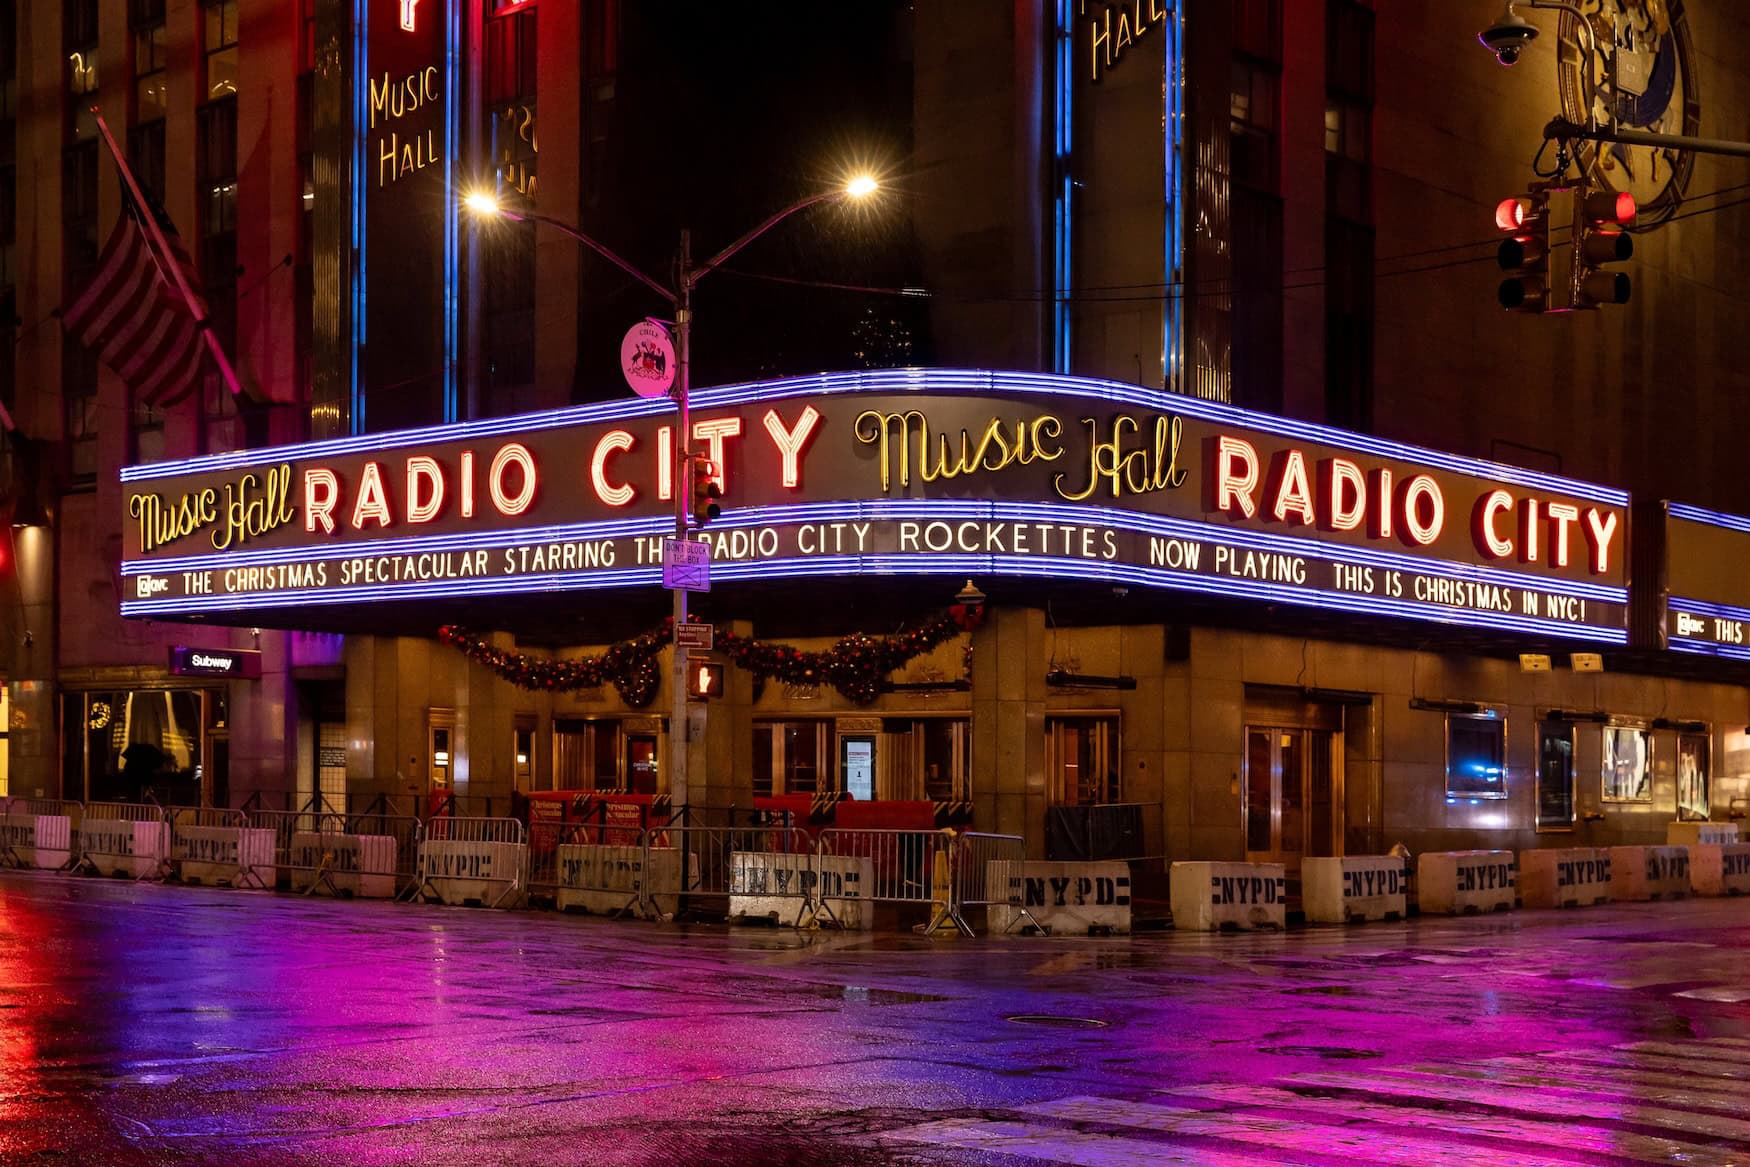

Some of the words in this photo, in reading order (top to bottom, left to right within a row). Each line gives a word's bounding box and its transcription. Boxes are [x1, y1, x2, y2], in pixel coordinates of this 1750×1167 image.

[370, 66, 439, 128] MUSIC
[379, 129, 438, 187] HALL
[129, 491, 217, 553] Music
[210, 463, 294, 551] Hall
[304, 442, 537, 534] RADIO
[591, 405, 821, 508] CITY
[854, 409, 1066, 491] Music
[1054, 414, 1187, 501] Hall
[1217, 434, 1445, 546] RADIO
[1482, 489, 1618, 574] CITY
[183, 571, 213, 595] THE
[225, 561, 327, 592] CHRISTMAS
[341, 549, 488, 585] SPECTACULAR
[504, 539, 615, 573] STARRING
[634, 536, 676, 564] TH
[798, 522, 870, 554] CITY
[900, 521, 1117, 560] ROCKETTES
[1150, 537, 1200, 571] NOW
[1215, 546, 1306, 584] PLAYING
[1333, 563, 1374, 594] THIS
[1385, 572, 1403, 597] IS
[1414, 575, 1512, 613] CHRISTMAS
[1523, 592, 1539, 616] IN
[1547, 596, 1587, 622] NYC!
[1715, 618, 1743, 644] THIS
[192, 654, 232, 670] Subway
[1351, 869, 1398, 896] NYPD
[1465, 864, 1508, 891] NYPD
[1564, 860, 1605, 886] NYPD
[1025, 877, 1116, 906] NYPD
[1222, 877, 1276, 904] NYPD
